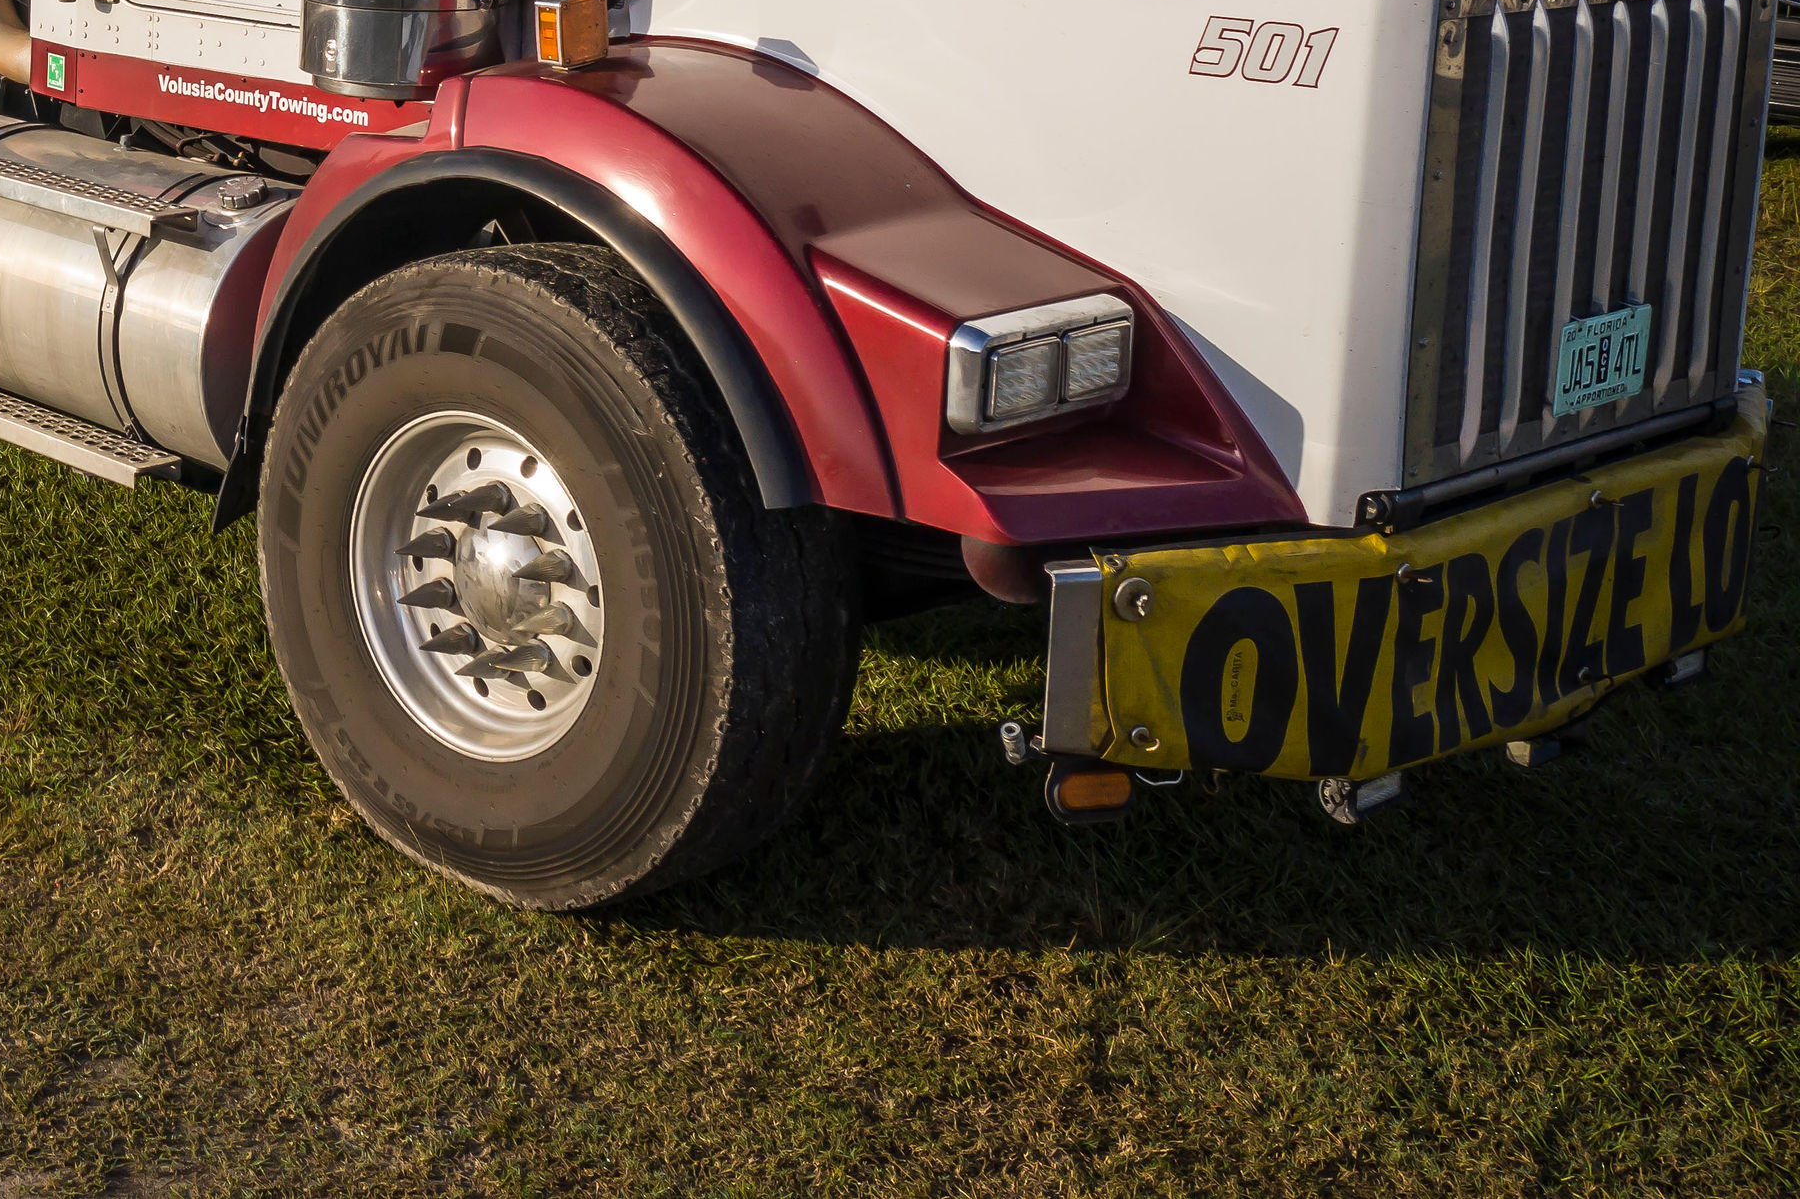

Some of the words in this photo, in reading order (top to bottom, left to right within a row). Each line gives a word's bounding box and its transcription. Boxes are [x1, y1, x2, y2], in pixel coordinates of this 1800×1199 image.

[1189, 15, 1340, 89] 501
[157, 73, 369, 127] VolusiaCountyTowing.com
[1586, 316, 1628, 338] FLORIDA
[1575, 383, 1625, 406] APPORTIONED
[1180, 487, 1655, 777] OVERSIZE
